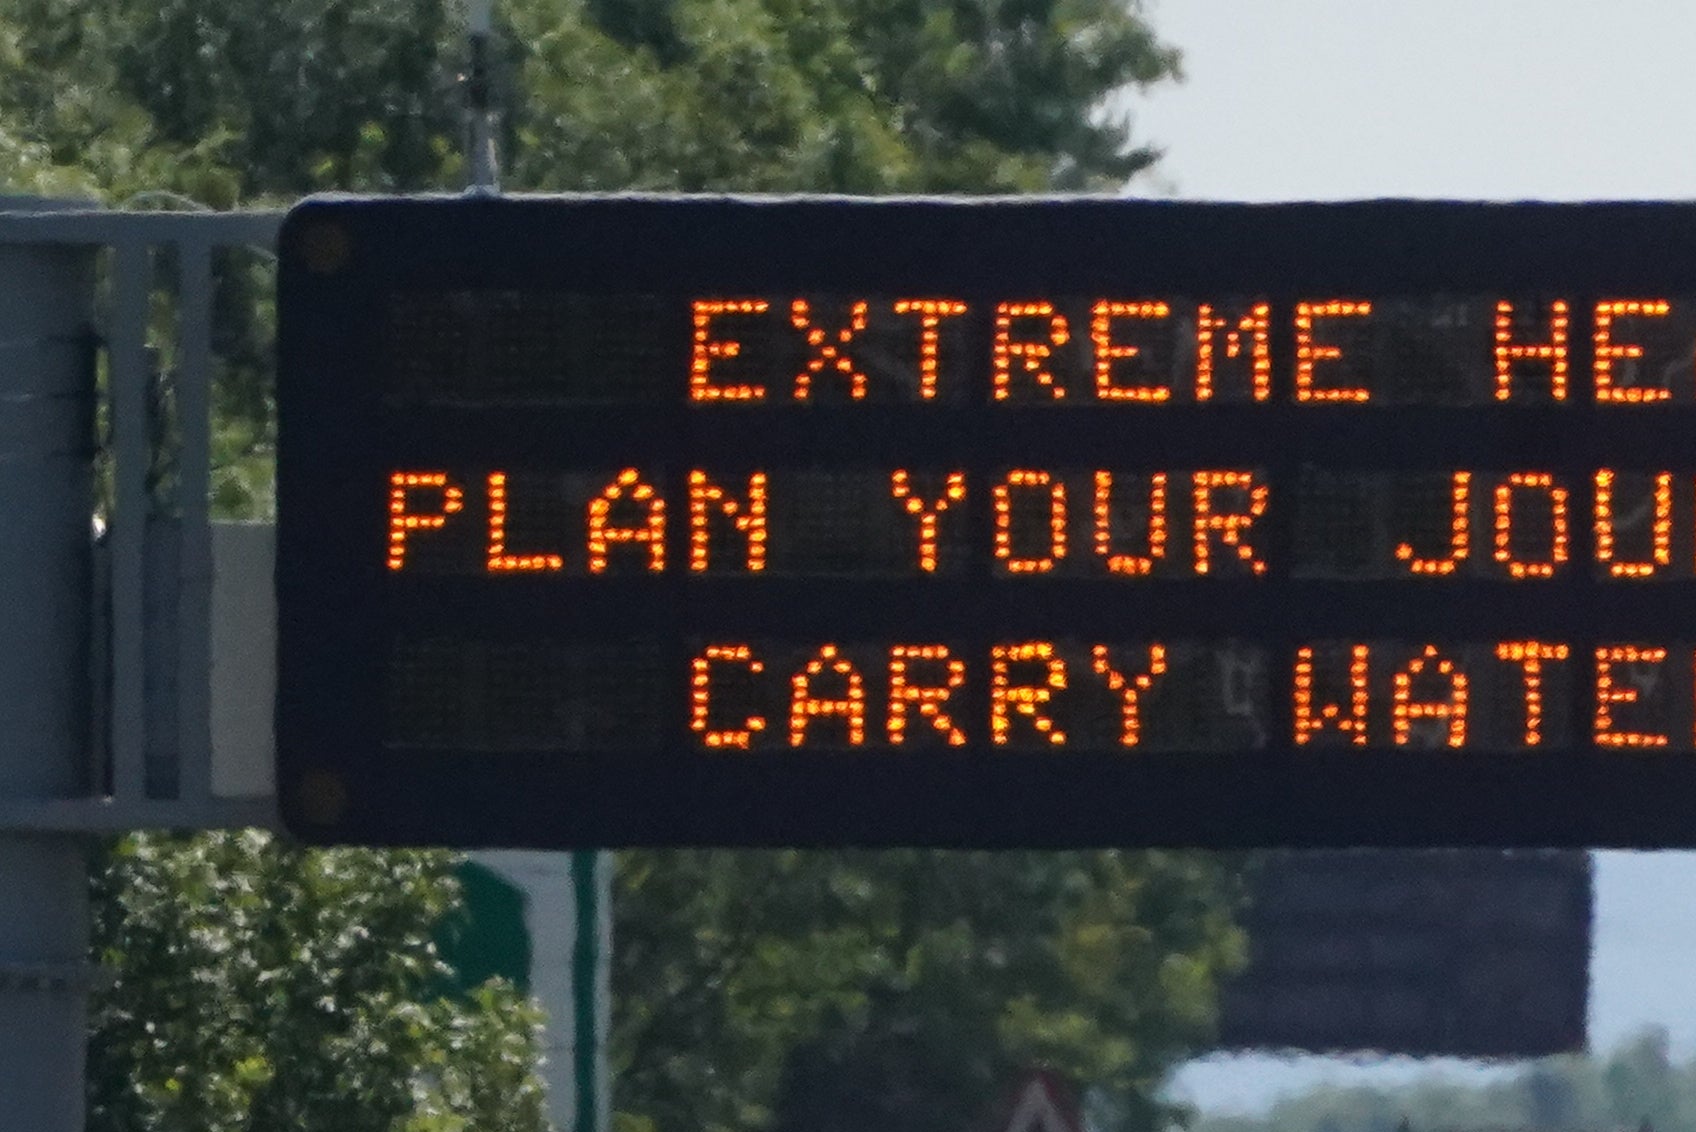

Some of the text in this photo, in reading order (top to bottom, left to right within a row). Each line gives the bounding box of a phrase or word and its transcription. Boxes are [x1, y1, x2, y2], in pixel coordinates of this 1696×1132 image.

[690, 299, 1371, 403] EXTREME
[387, 468, 767, 573] PLAN
[891, 469, 1269, 575] YOUR
[690, 641, 1167, 749] CARRY
